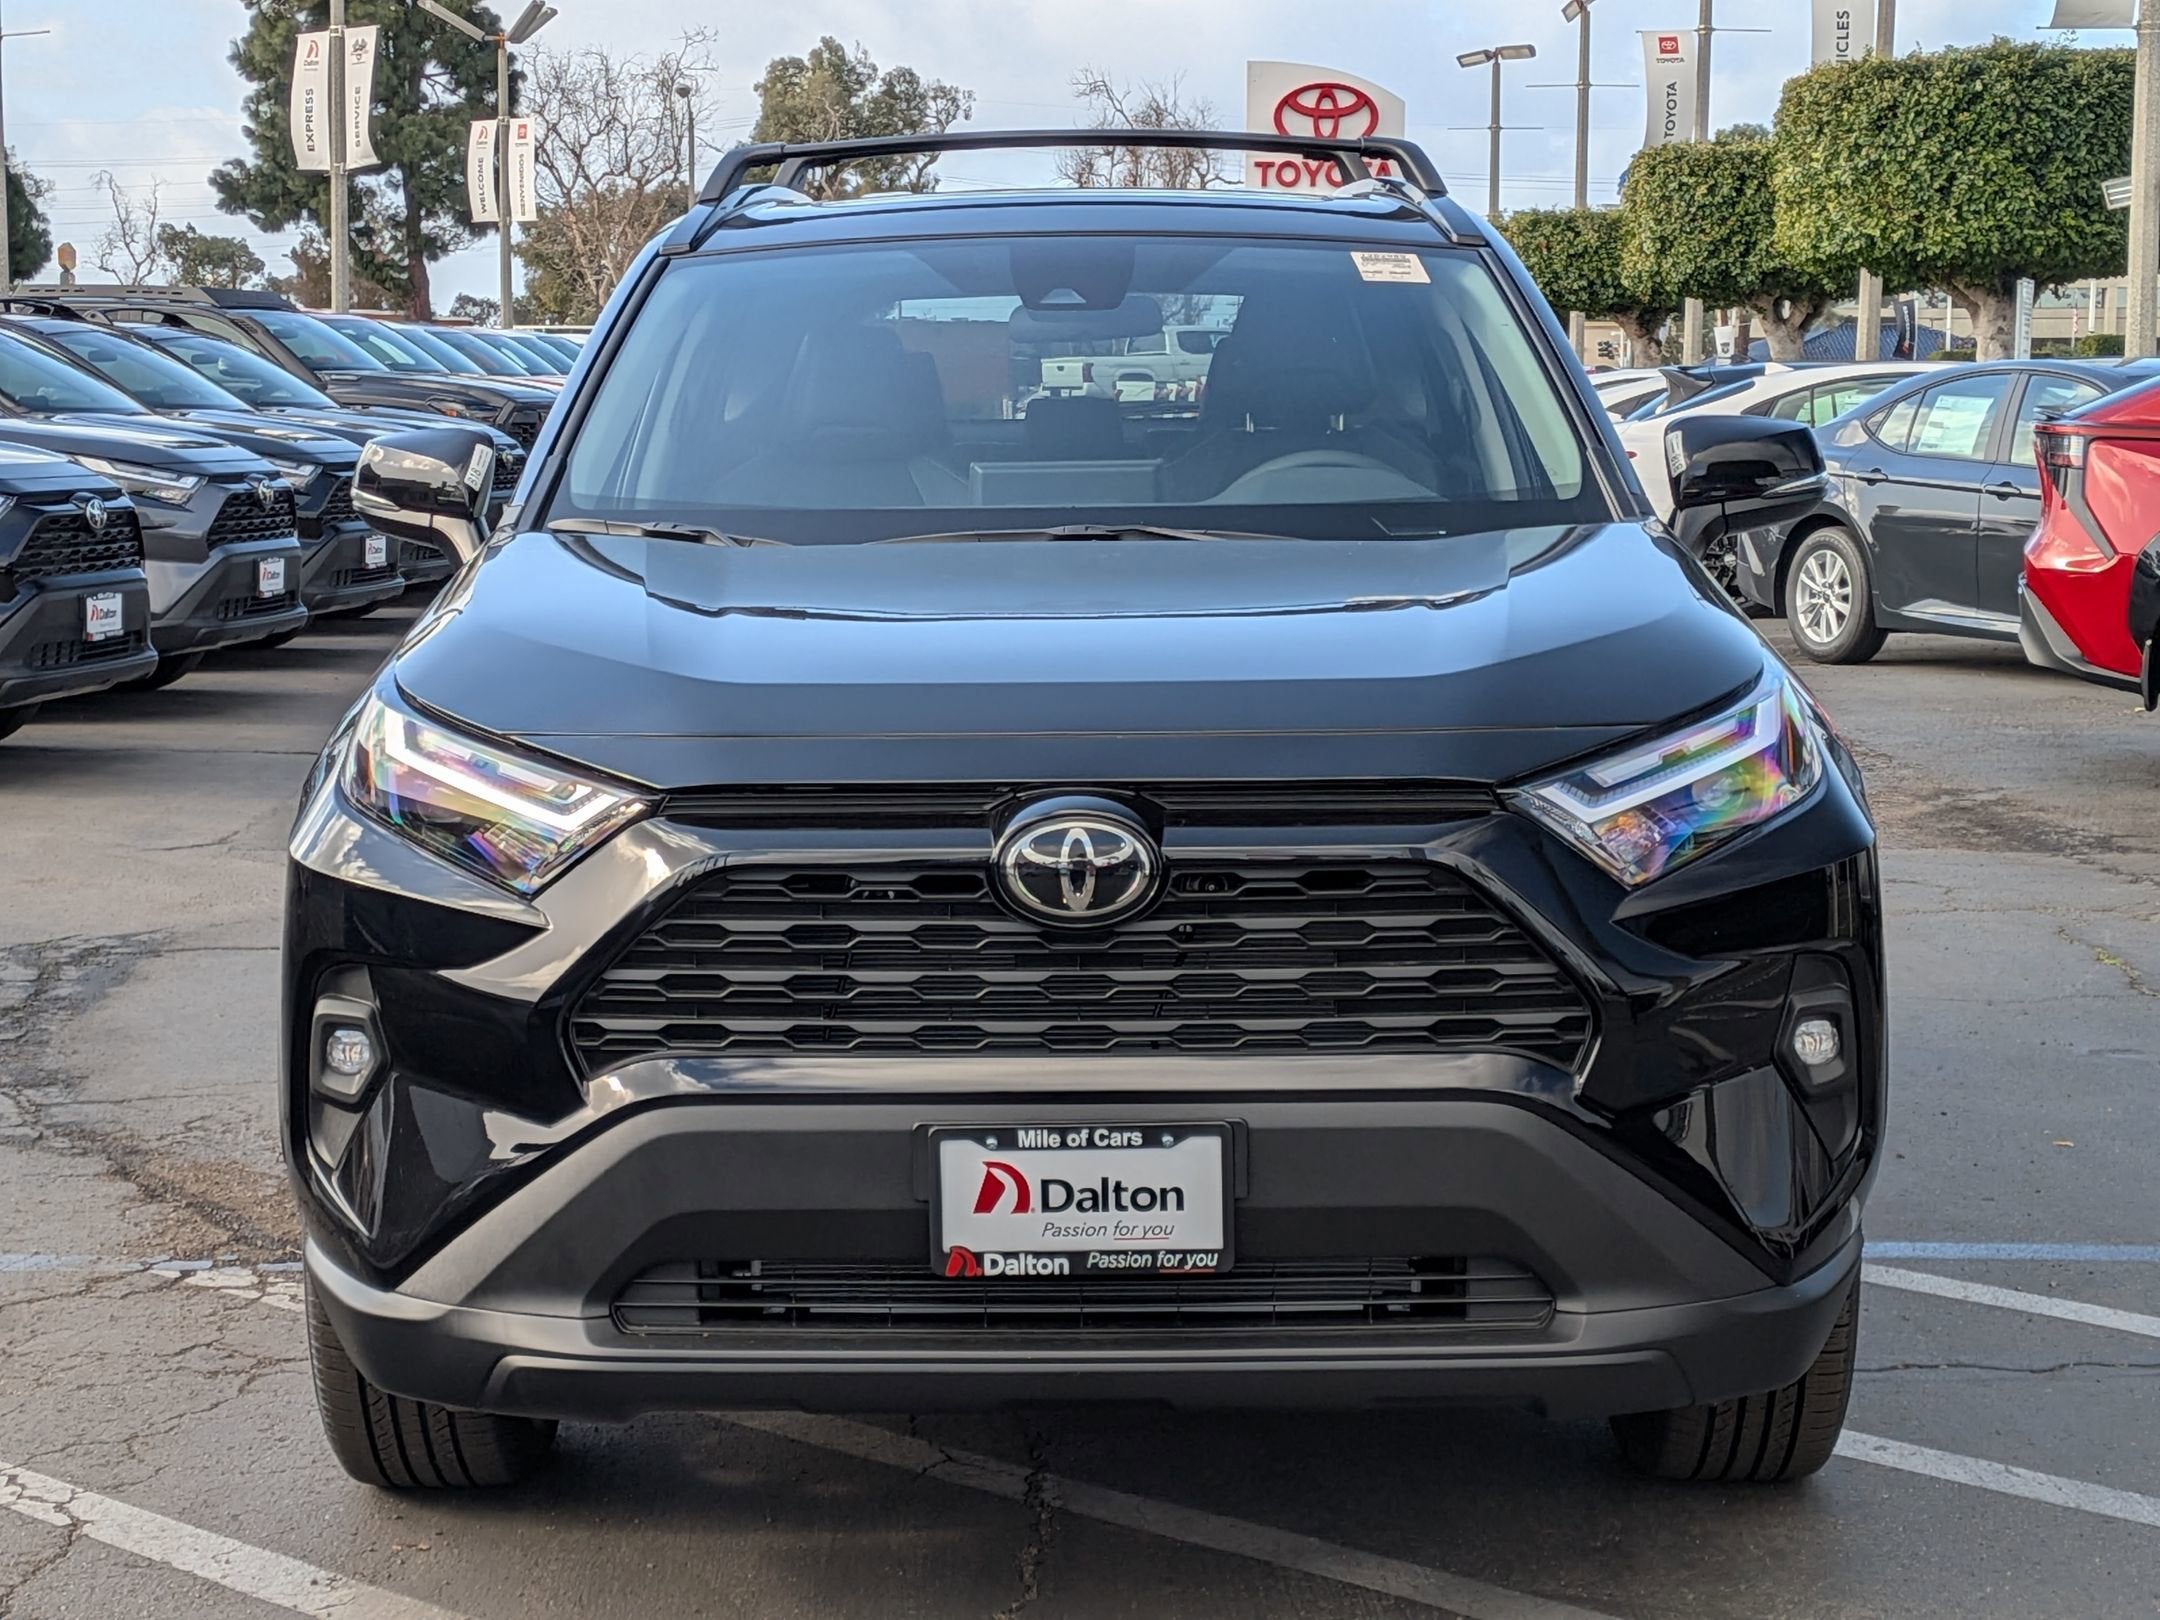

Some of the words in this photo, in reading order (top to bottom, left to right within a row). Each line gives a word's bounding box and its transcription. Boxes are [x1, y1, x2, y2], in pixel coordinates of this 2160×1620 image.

[305, 88, 315, 152] EXPRESS
[1664, 81, 1678, 139] TOYOTA
[477, 157, 487, 214] WELCOME
[1254, 159, 1393, 188] TOYOA
[1017, 1129, 1061, 1149] Mile
[1066, 1128, 1088, 1148] of
[1094, 1128, 1143, 1148] Cars
[1040, 1177, 1184, 1213] Dalton
[1041, 1222, 1107, 1238] Passion
[1113, 1221, 1138, 1238] for
[1142, 1223, 1174, 1239] you
[984, 1253, 1070, 1275] Dalton
[1087, 1251, 1152, 1268] Passion
[1157, 1250, 1182, 1269] for
[1184, 1252, 1218, 1270] you
